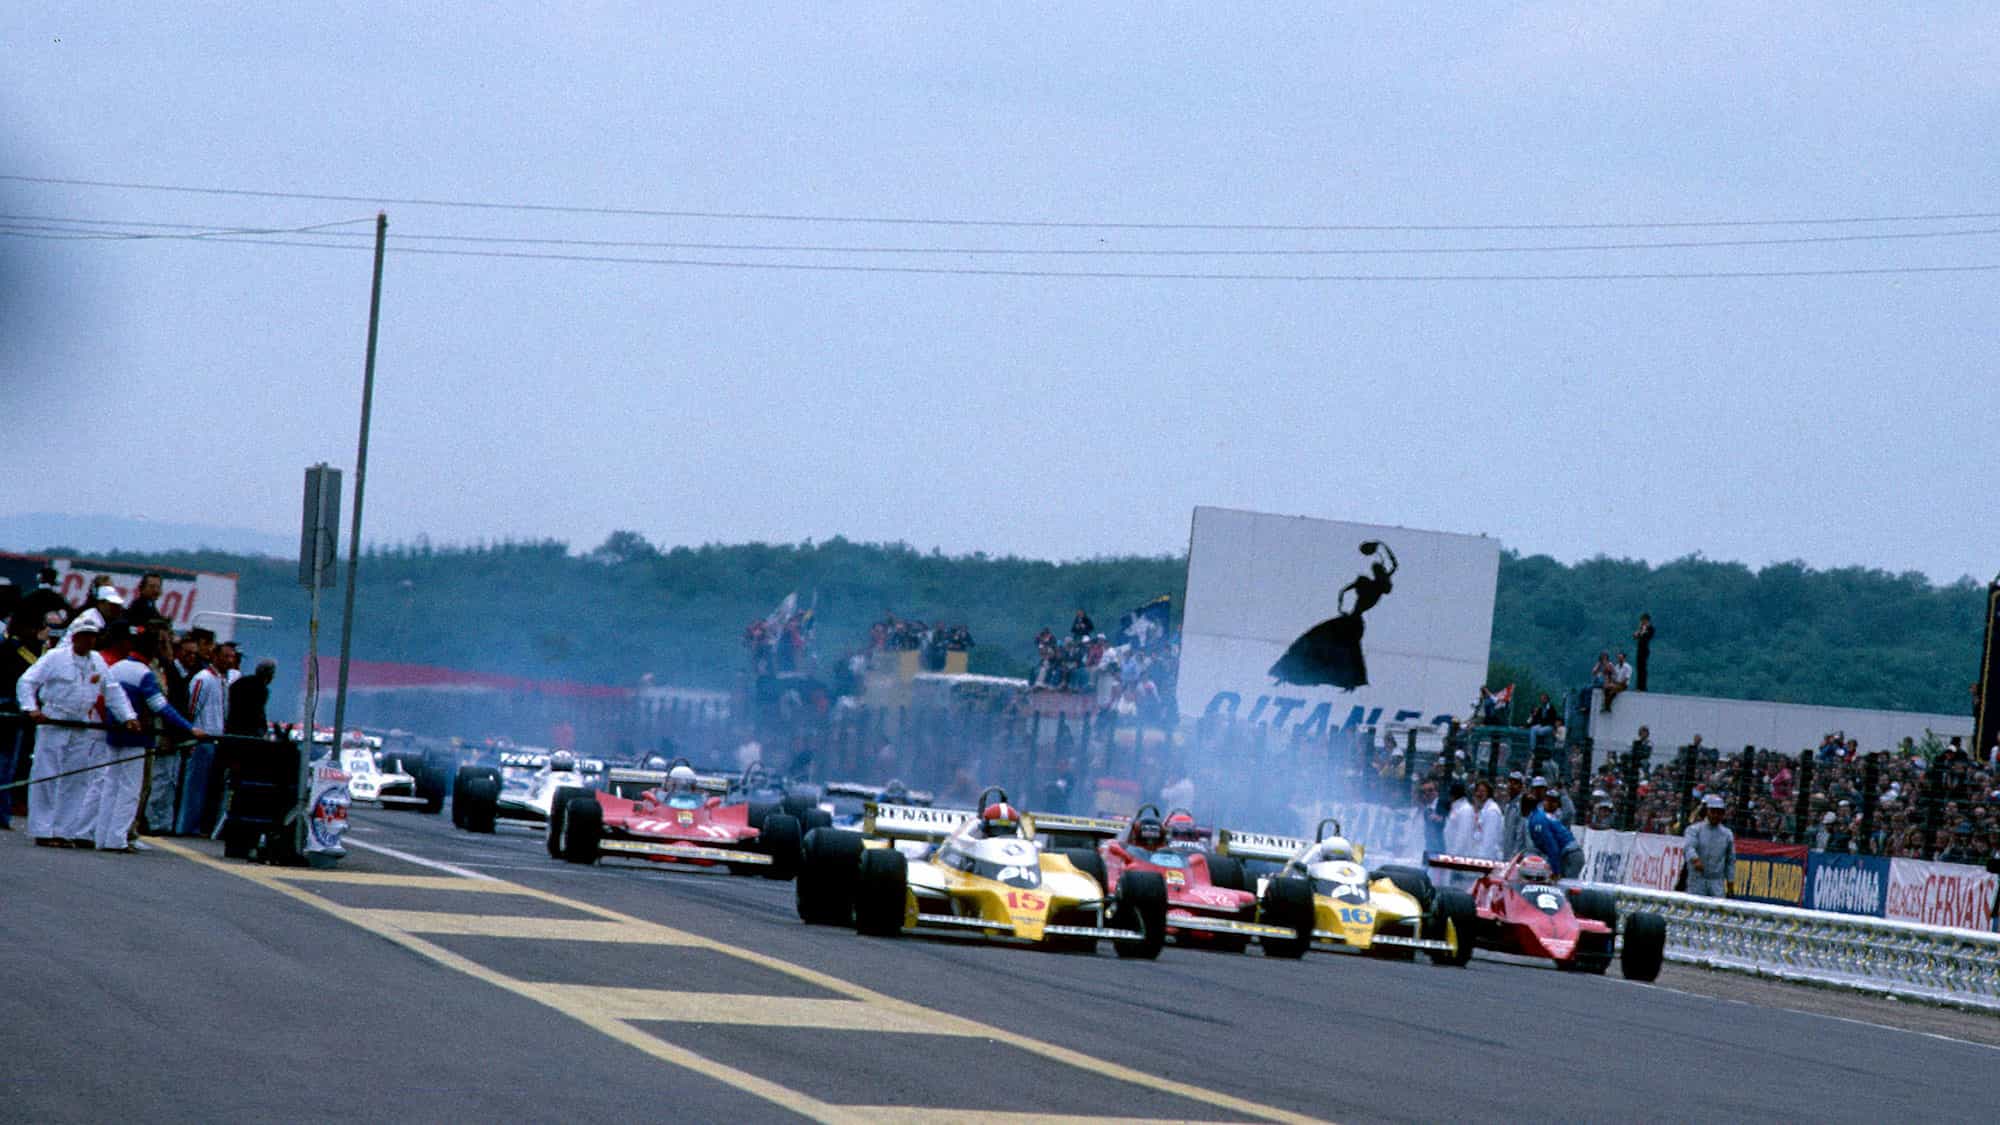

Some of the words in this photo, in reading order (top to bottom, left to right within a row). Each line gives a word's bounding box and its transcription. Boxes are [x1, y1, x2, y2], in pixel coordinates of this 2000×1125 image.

[1228, 831, 1309, 849] RENAULT
[1813, 864, 1879, 912] ORANGINA
[1007, 891, 1046, 911] 15
[1920, 873, 1995, 931] GERVAIS
[1339, 907, 1373, 924] 16
